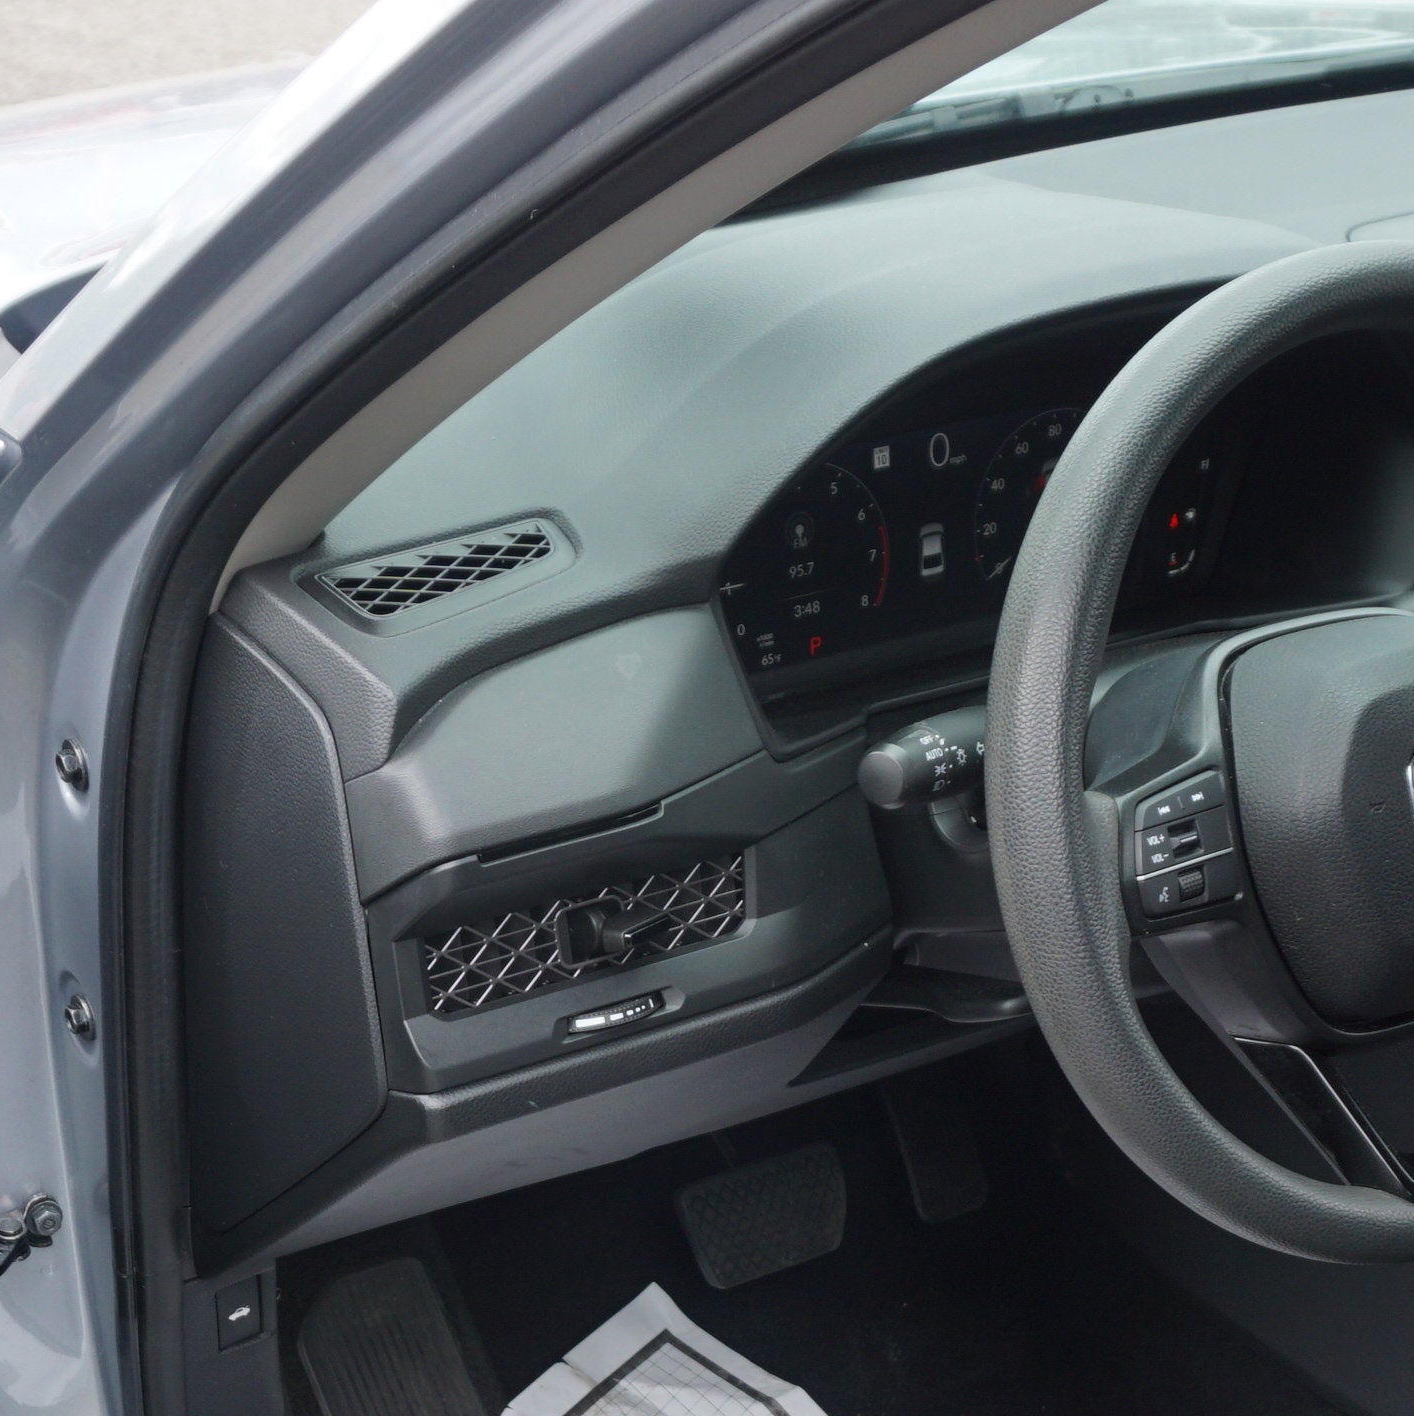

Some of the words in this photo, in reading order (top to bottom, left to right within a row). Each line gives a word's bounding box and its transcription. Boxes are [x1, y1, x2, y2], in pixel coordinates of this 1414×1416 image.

[1047, 423, 1062, 437] 80
[930, 432, 949, 467] 0
[1015, 441, 1029, 454] 60
[830, 481, 838, 495] 5
[991, 478, 1005, 491] 40
[857, 508, 866, 521] 6
[983, 522, 997, 536] 20
[869, 549, 876, 562] 7
[789, 561, 815, 578] 95.7
[861, 594, 869, 607] 8
[794, 600, 821, 618] 3:48
[737, 623, 746, 636] 0
[810, 636, 823, 656] P
[919, 734, 934, 745] OFF
[925, 747, 944, 761] AUTO
